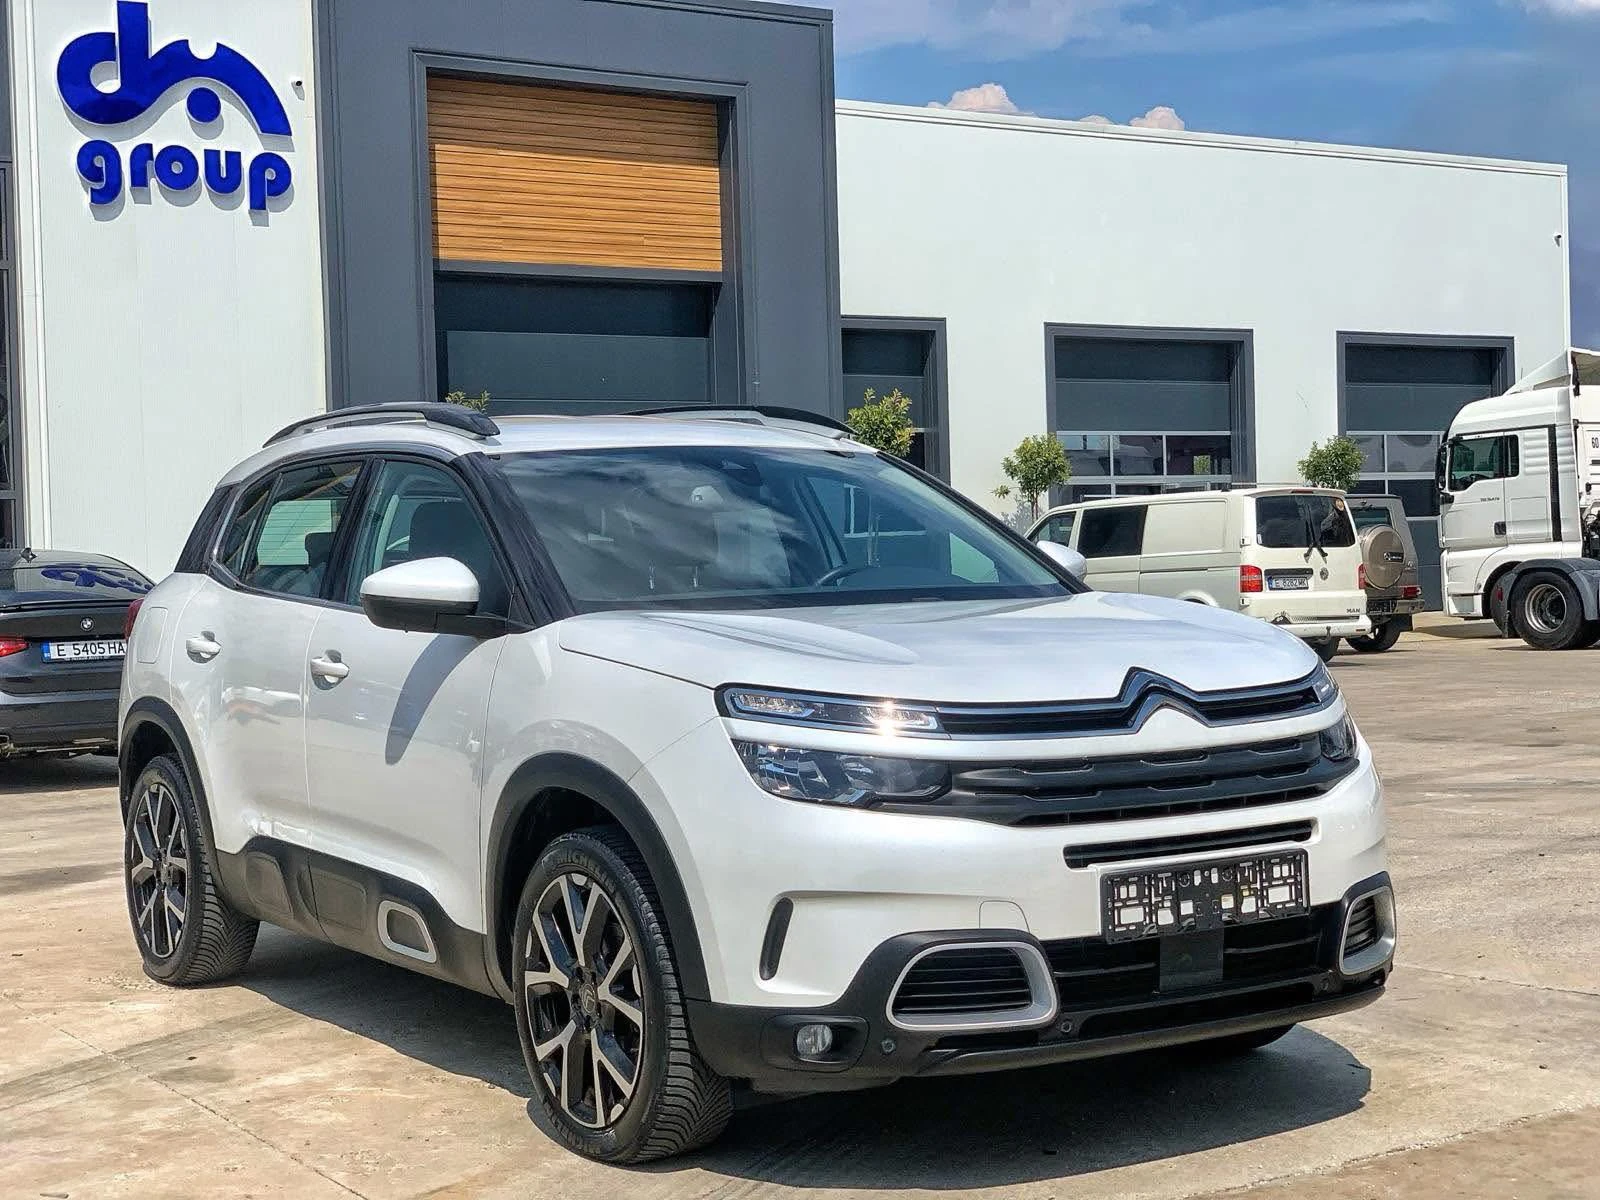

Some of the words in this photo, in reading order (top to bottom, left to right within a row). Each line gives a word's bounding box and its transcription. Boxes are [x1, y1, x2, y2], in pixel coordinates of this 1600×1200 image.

[77, 139, 292, 211] group
[57, 644, 66, 656] E
[73, 642, 106, 656] 5405
[107, 641, 125, 655] HA
